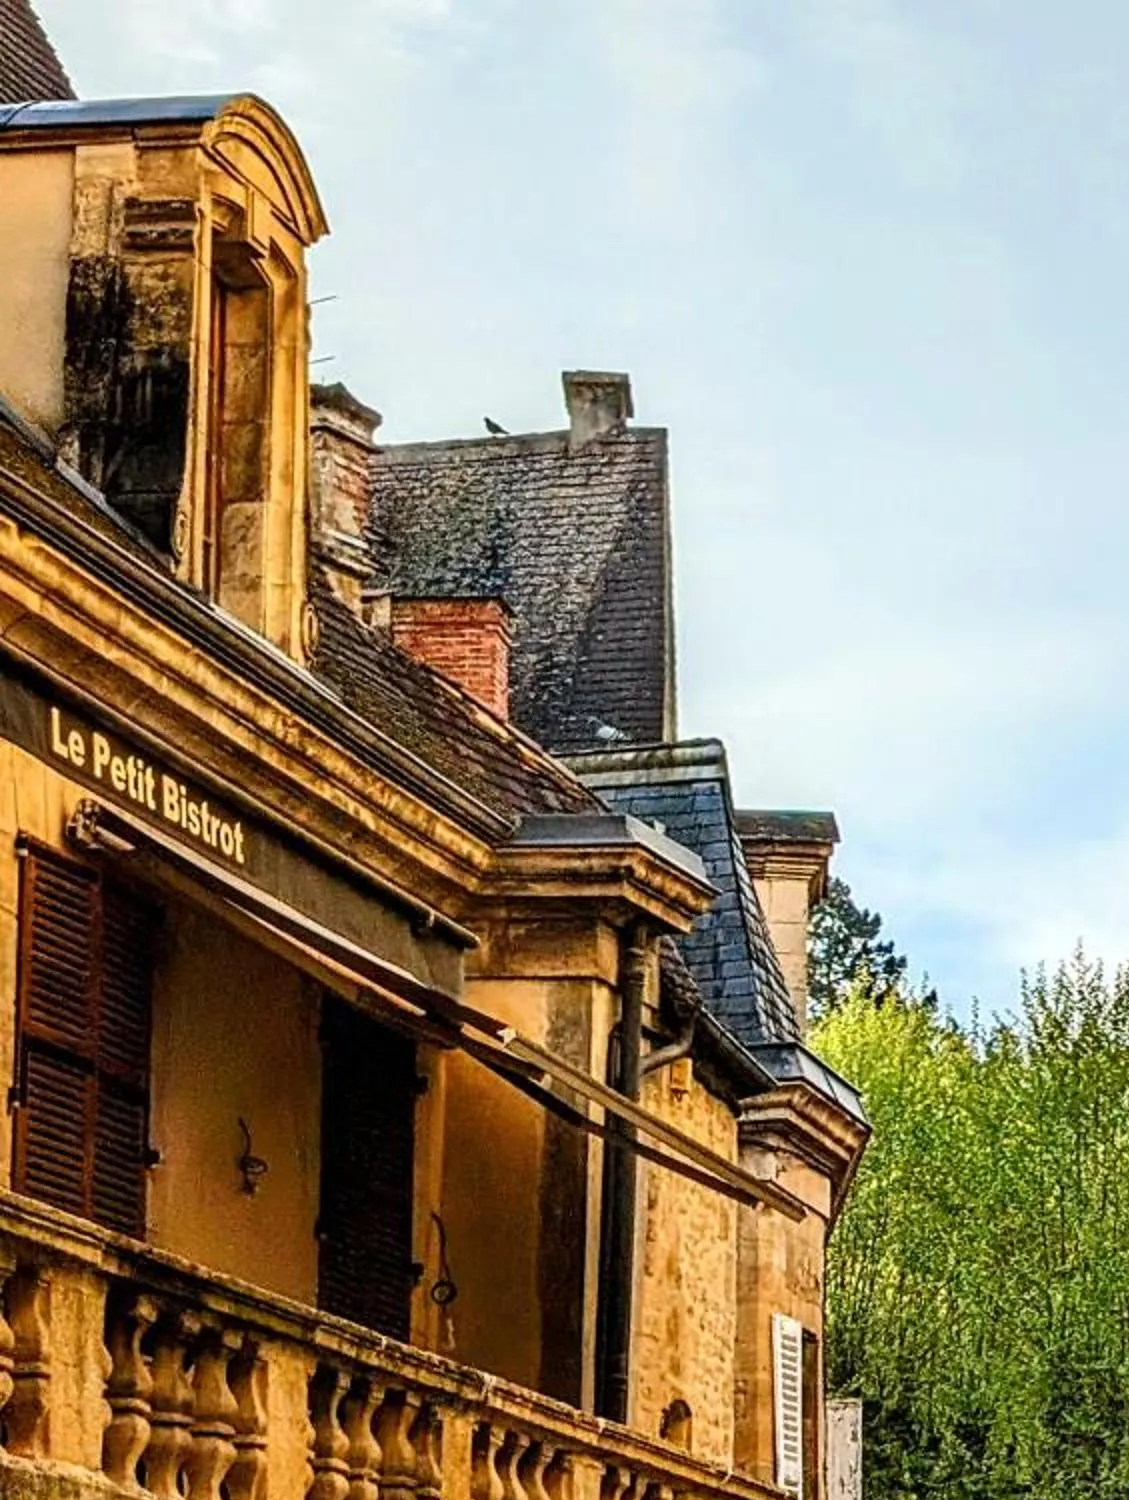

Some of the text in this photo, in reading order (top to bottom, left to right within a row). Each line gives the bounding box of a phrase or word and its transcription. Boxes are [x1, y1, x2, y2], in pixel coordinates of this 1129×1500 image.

[50, 706, 245, 864] Le Petit Bistrot
